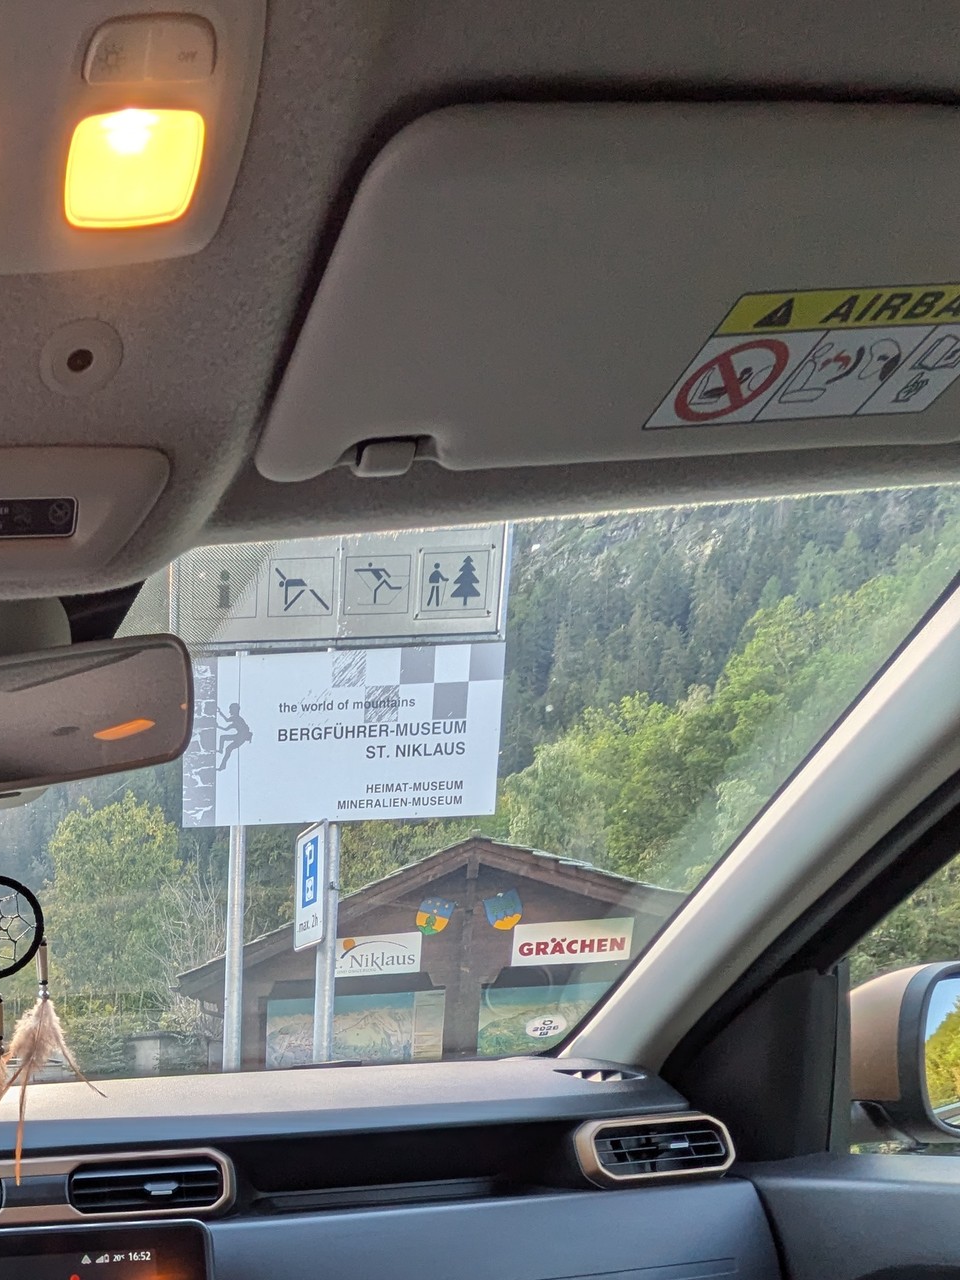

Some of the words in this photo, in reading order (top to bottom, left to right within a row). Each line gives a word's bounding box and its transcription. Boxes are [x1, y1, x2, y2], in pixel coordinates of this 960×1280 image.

[278, 702, 298, 713] the
[301, 700, 334, 712] world
[337, 699, 349, 711] of
[352, 697, 416, 711] mountains
[277, 720, 467, 743] BERGFÜHRER-MUSEUM
[365, 745, 391, 760] ST.
[395, 741, 466, 759] NIKLAUS
[365, 780, 464, 794] HEIMAT-MUSEUM
[337, 795, 463, 810] MINERALIEN-MUSEUM
[518, 937, 626, 957] GRÄCHEN
[349, 952, 416, 971] Niklaus
[128, 1251, 151, 1261] 16:52
